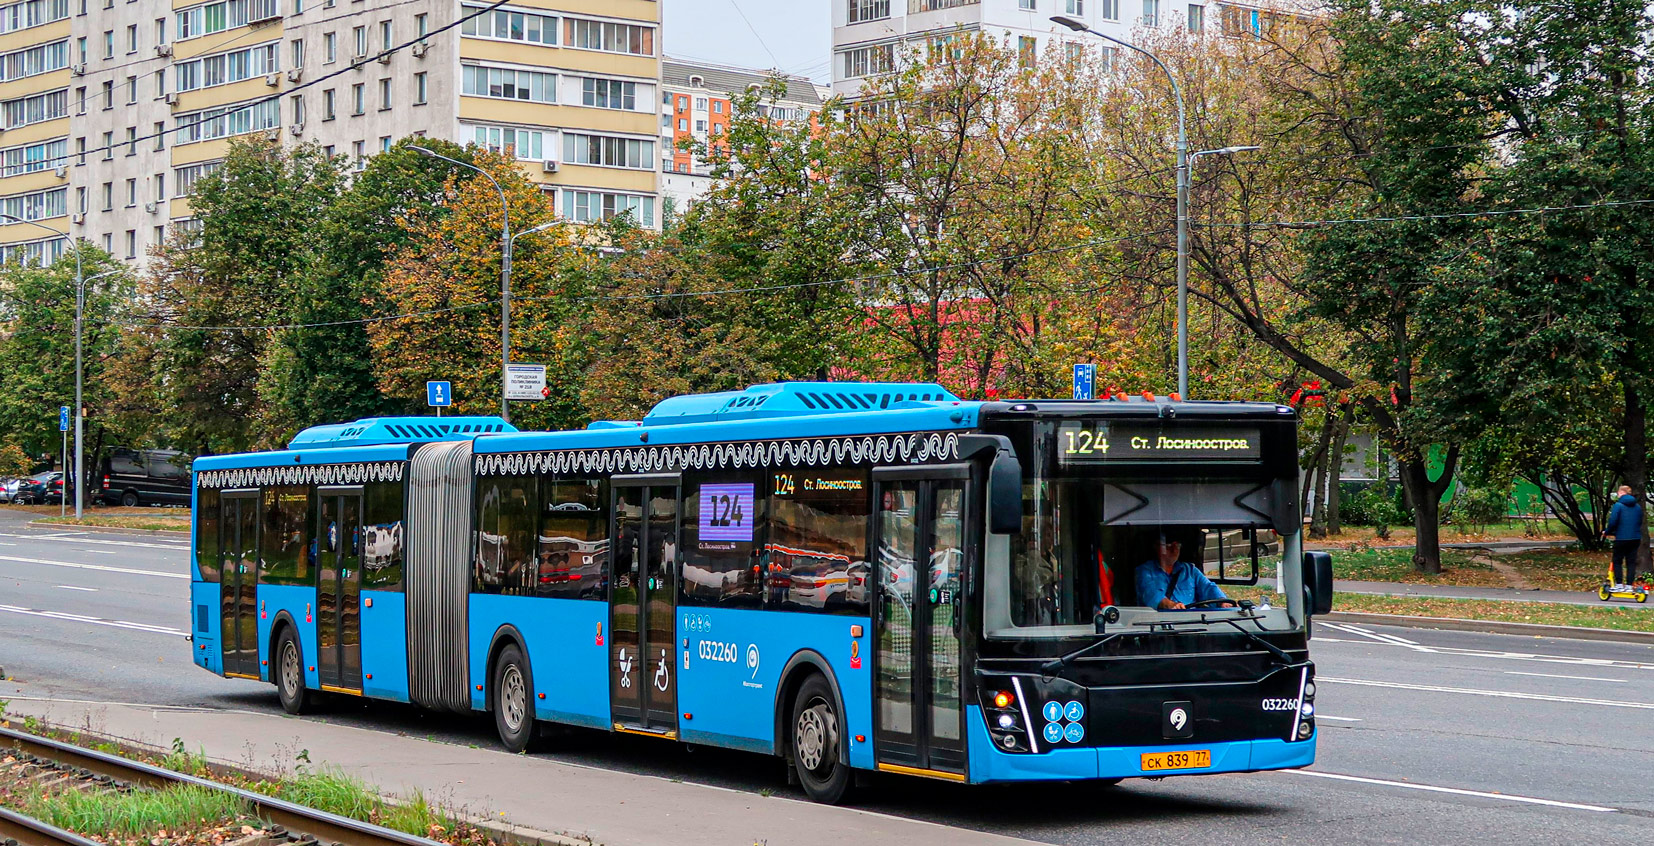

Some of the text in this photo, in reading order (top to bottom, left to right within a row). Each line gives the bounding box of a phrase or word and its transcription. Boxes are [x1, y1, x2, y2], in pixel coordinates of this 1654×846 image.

[1065, 430, 1250, 454] 124 Ст. Лосиноостров.
[774, 474, 863, 495] 124 Ст. Лосиноостров.
[710, 494, 743, 527] 124
[698, 639, 738, 663] 032260
[1261, 698, 1299, 711] 032260
[1147, 751, 1207, 768] СК 839 77
